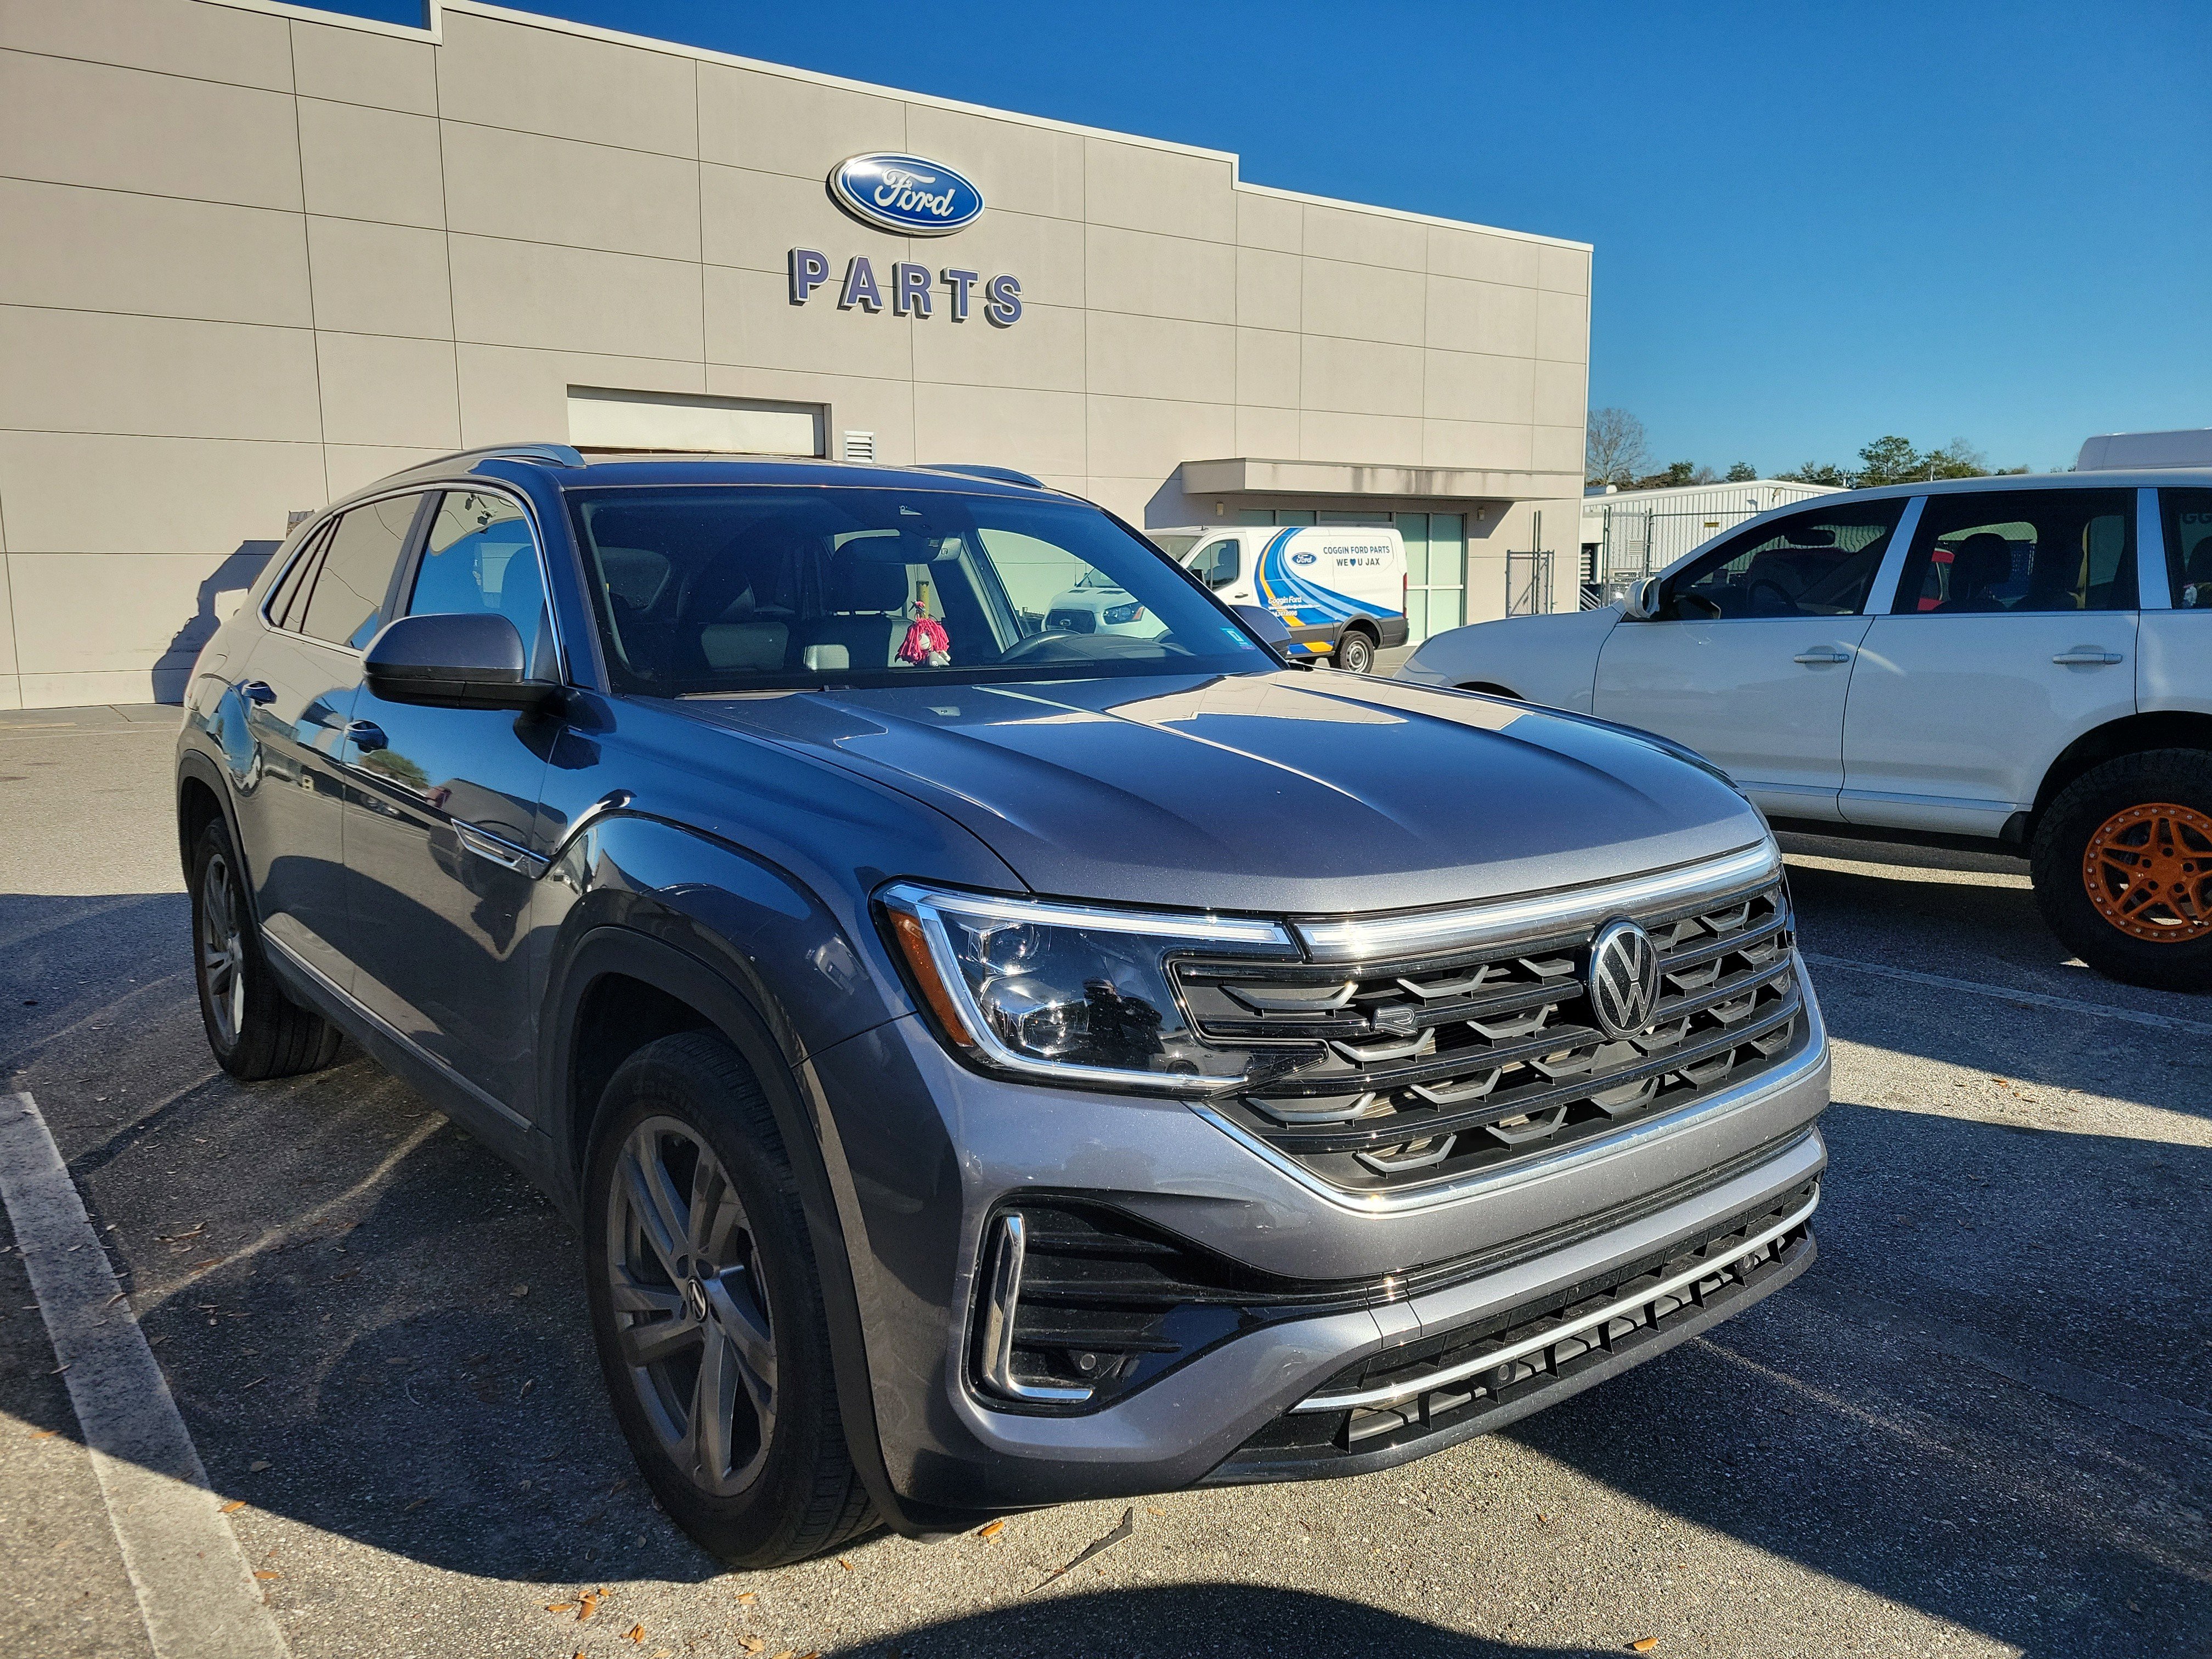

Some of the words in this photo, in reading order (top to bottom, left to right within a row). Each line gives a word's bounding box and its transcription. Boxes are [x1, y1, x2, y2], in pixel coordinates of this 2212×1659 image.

[873, 167, 957, 217] Ford
[792, 246, 1024, 326] PARTS
[1296, 554, 1312, 563] Ford
[1268, 596, 1288, 605] Coggin
